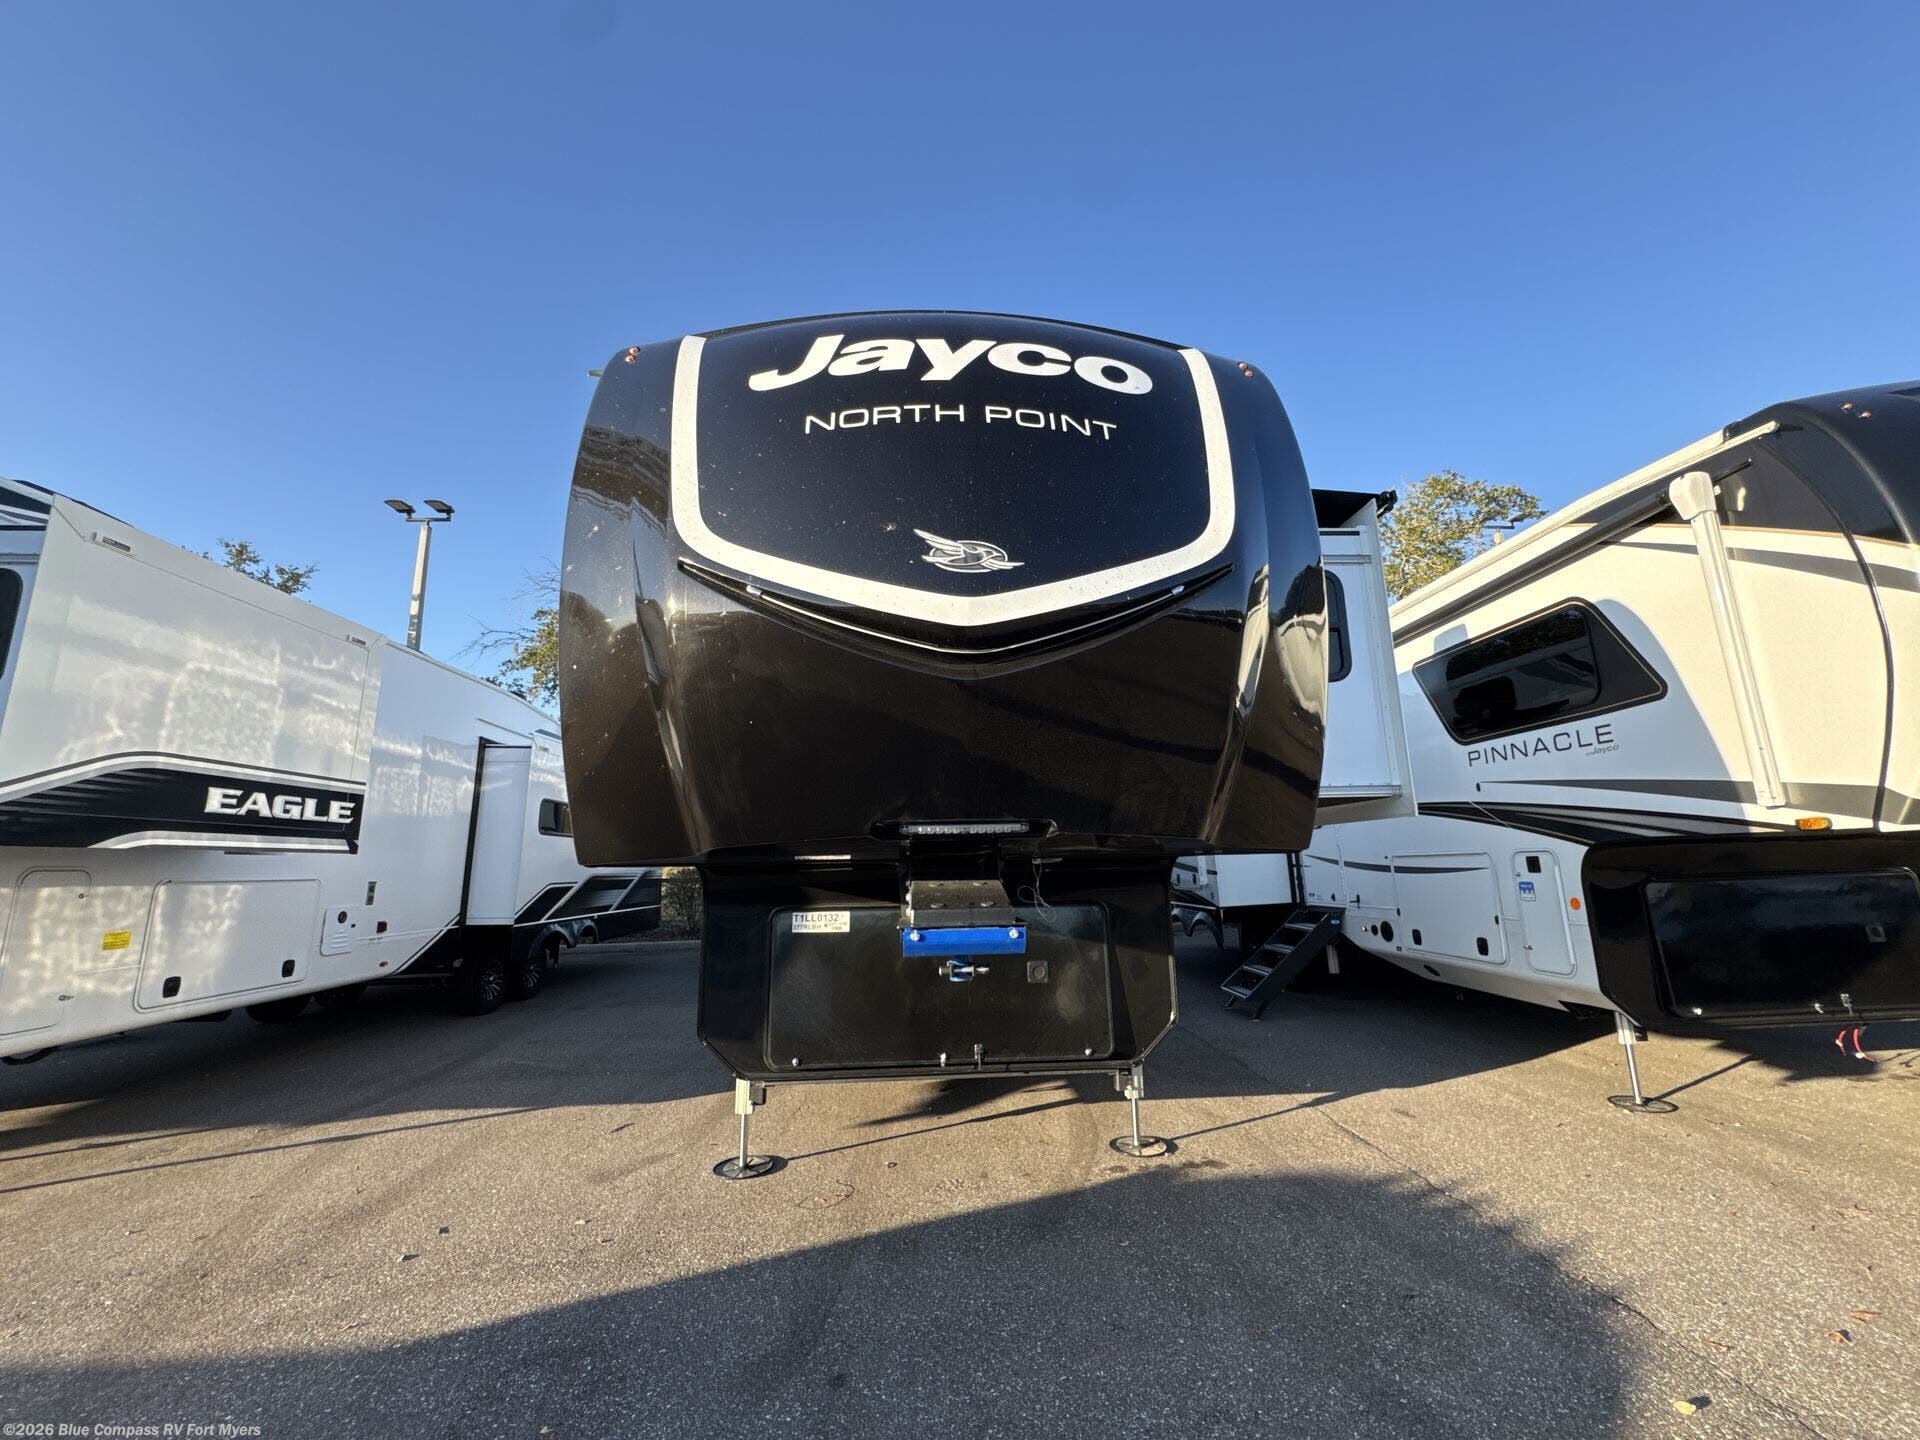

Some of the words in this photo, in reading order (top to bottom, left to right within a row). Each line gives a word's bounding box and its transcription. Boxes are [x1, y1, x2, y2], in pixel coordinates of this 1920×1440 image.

[748, 334, 1153, 395] Jayco
[805, 404, 965, 435] NORTH
[985, 405, 1117, 440] POINT
[1468, 723, 1614, 767] PINNACLE
[204, 786, 356, 824] EAGLE
